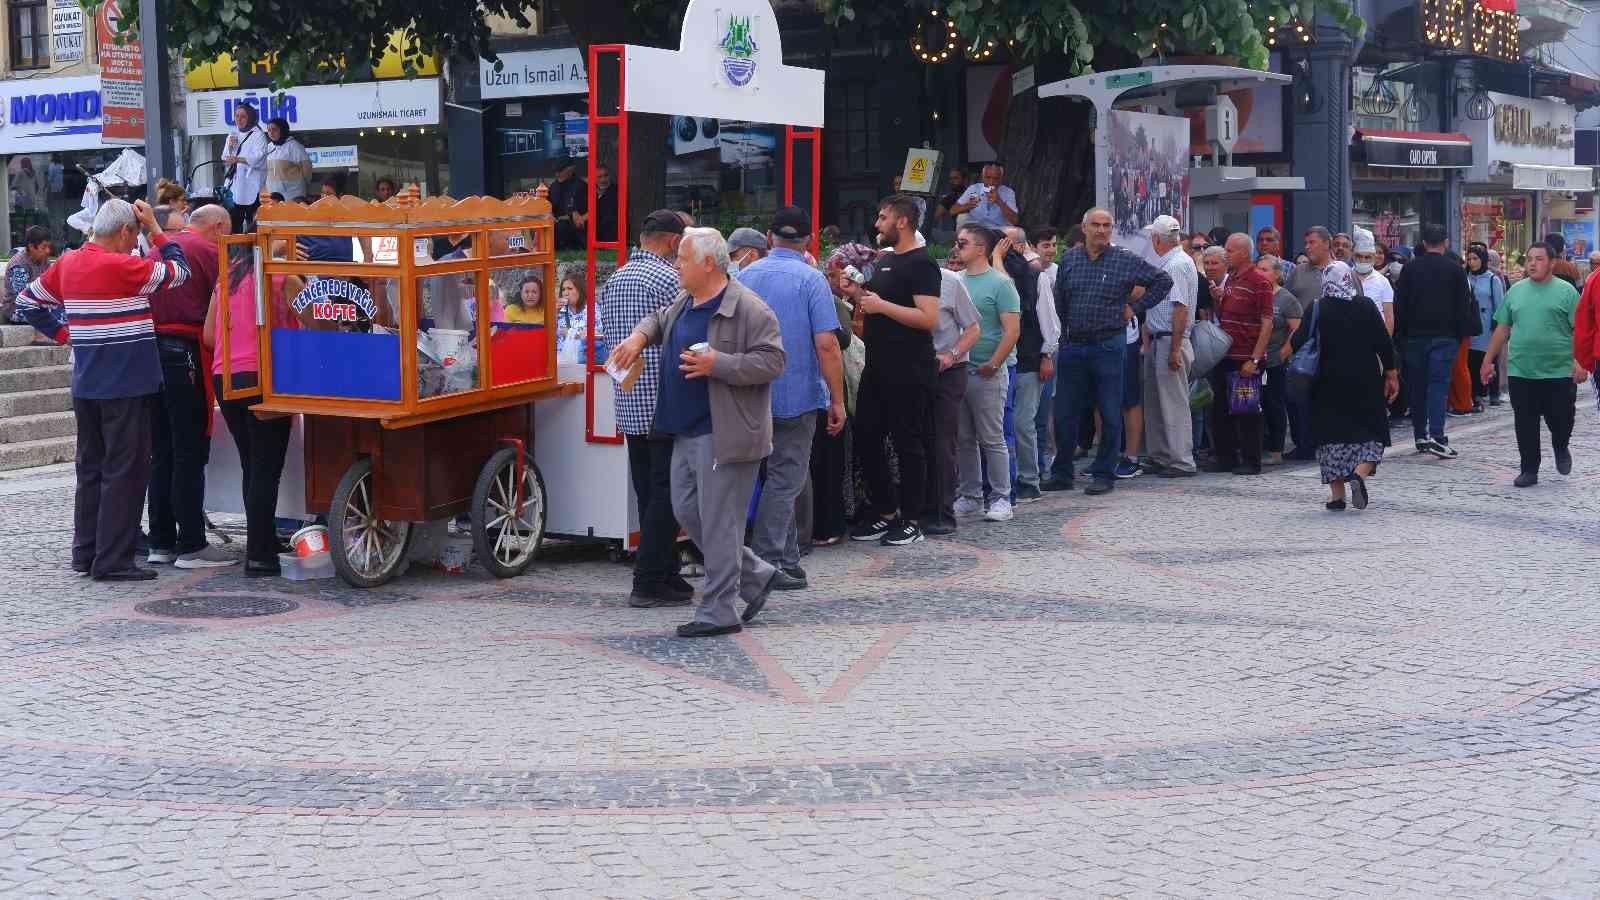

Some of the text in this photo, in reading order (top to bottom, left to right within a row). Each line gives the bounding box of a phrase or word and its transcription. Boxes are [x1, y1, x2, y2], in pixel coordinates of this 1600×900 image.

[55, 12, 80, 21] AVUKAT
[56, 35, 80, 48] AVUKAT
[485, 69, 518, 86] Uzun
[524, 64, 563, 84] İsmail
[400, 106, 426, 118] TİCARET
[1409, 149, 1420, 165] OJO
[292, 279, 348, 313] TENCEREDE
[313, 299, 357, 321] KÖFTE
